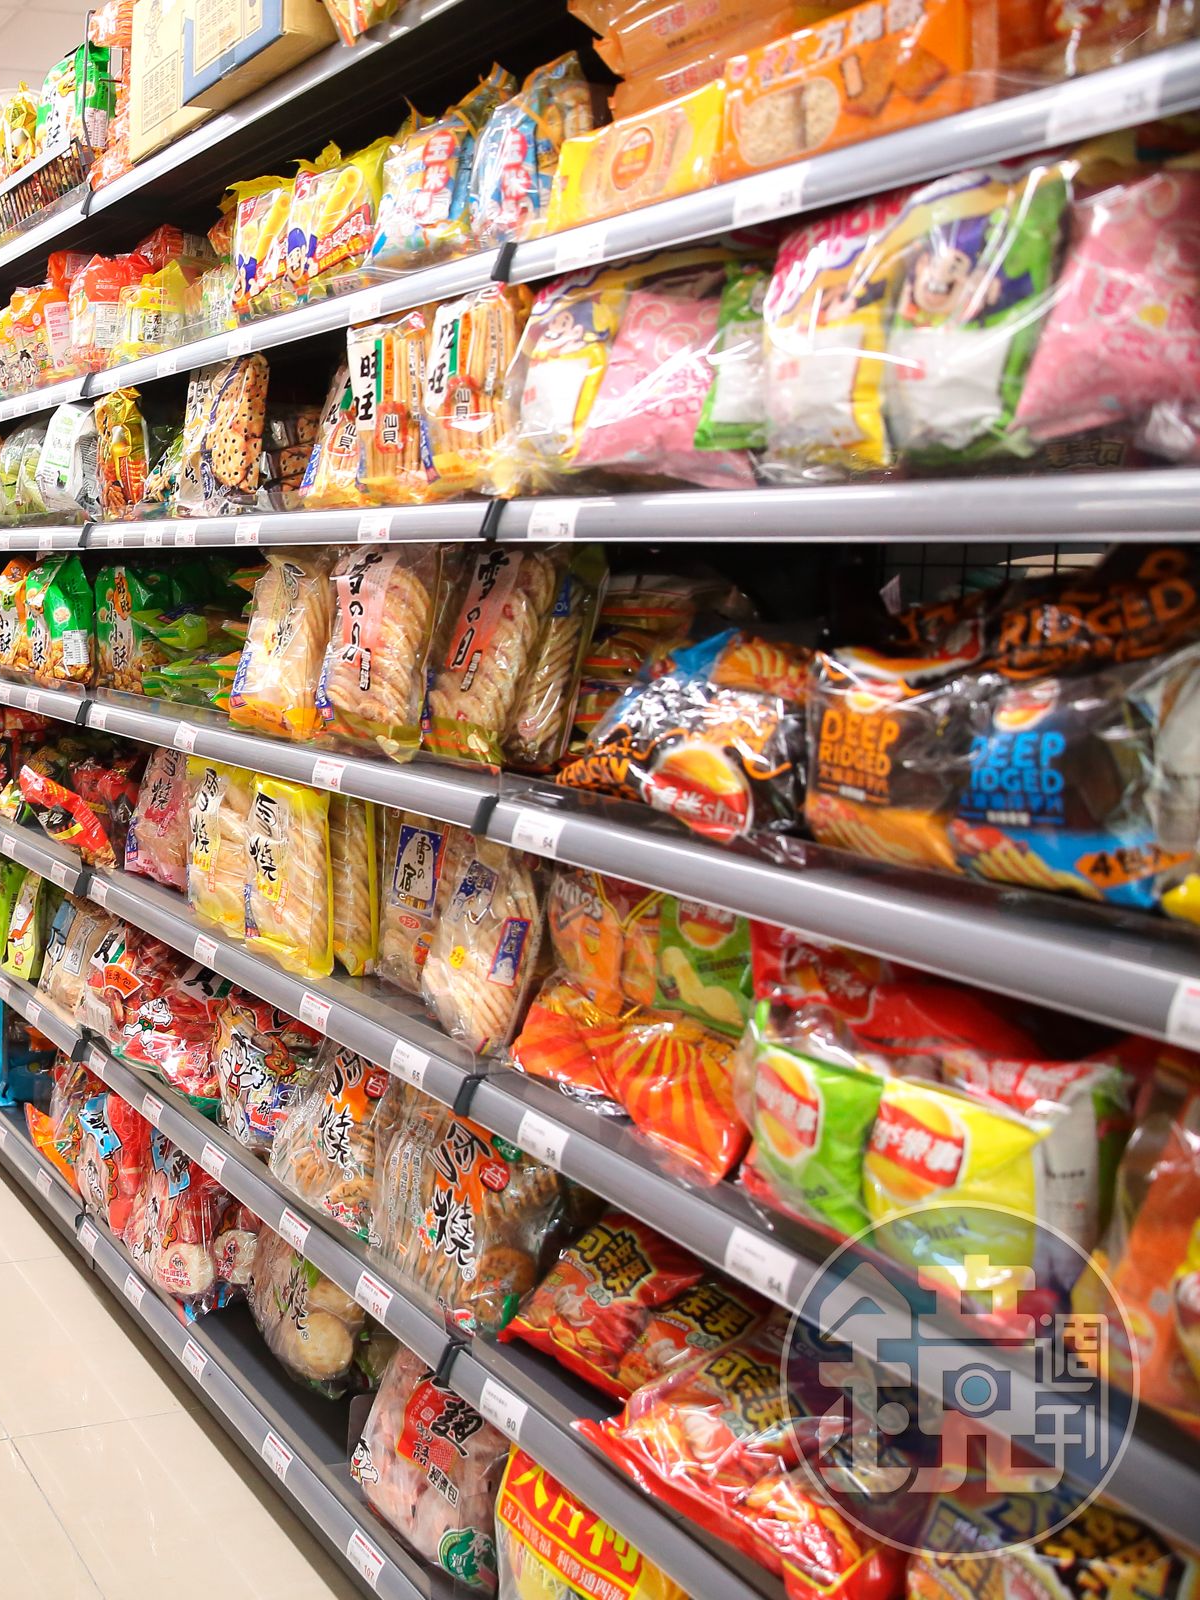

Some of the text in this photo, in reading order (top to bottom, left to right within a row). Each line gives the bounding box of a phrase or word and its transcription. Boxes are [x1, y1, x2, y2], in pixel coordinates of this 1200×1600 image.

[354, 350, 378, 420] 旺旺
[383, 413, 399, 443] 仙貝
[819, 708, 900, 751] DEEP
[818, 741, 892, 778] RIDGED
[412, 1070, 421, 1081] 65
[575, 1225, 652, 1299] 可樂果
[372, 1302, 384, 1316] 121
[506, 1416, 516, 1431] 80
[428, 1464, 458, 1506] 經濟包
[363, 1565, 374, 1580] 107
